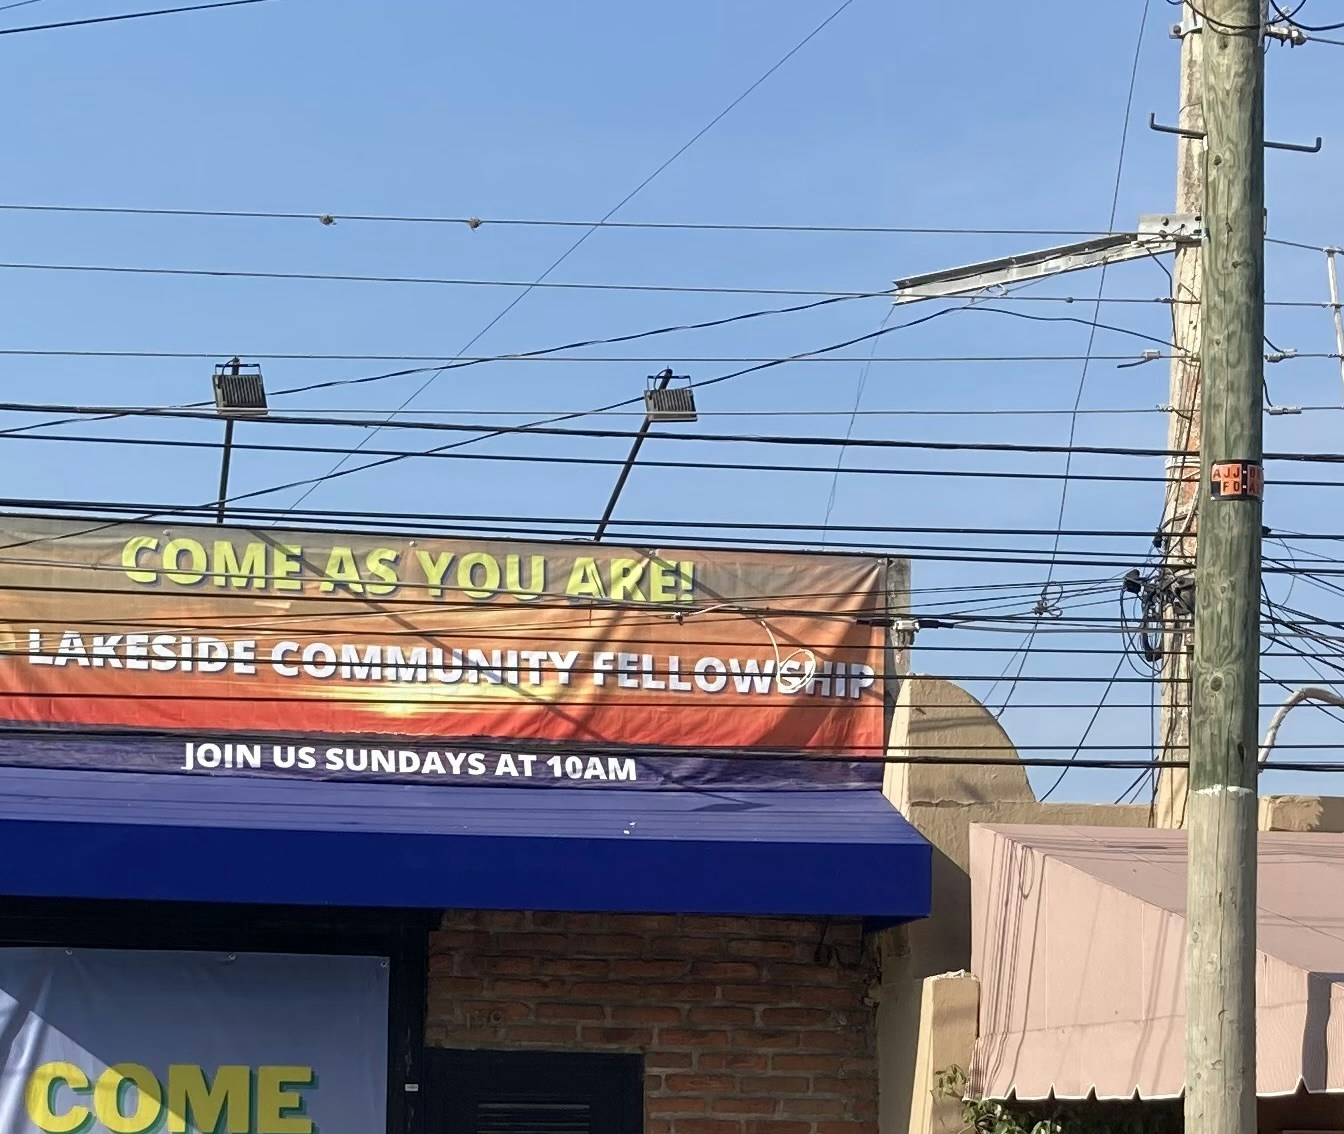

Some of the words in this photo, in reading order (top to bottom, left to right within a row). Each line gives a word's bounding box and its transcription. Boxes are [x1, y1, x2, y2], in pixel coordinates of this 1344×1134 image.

[121, 535, 304, 590] COME
[319, 546, 398, 595] AS
[415, 550, 546, 600] YOU
[565, 556, 695, 604] ARE!
[28, 628, 256, 675] LAKESIDE
[271, 640, 580, 687] COMMUNITY
[592, 650, 876, 699] FELLOWSHIP
[181, 742, 261, 770] JOIN
[272, 745, 317, 770] US
[325, 748, 486, 775] SUNDAYS
[494, 753, 537, 777] AT
[547, 755, 637, 781] 10AM
